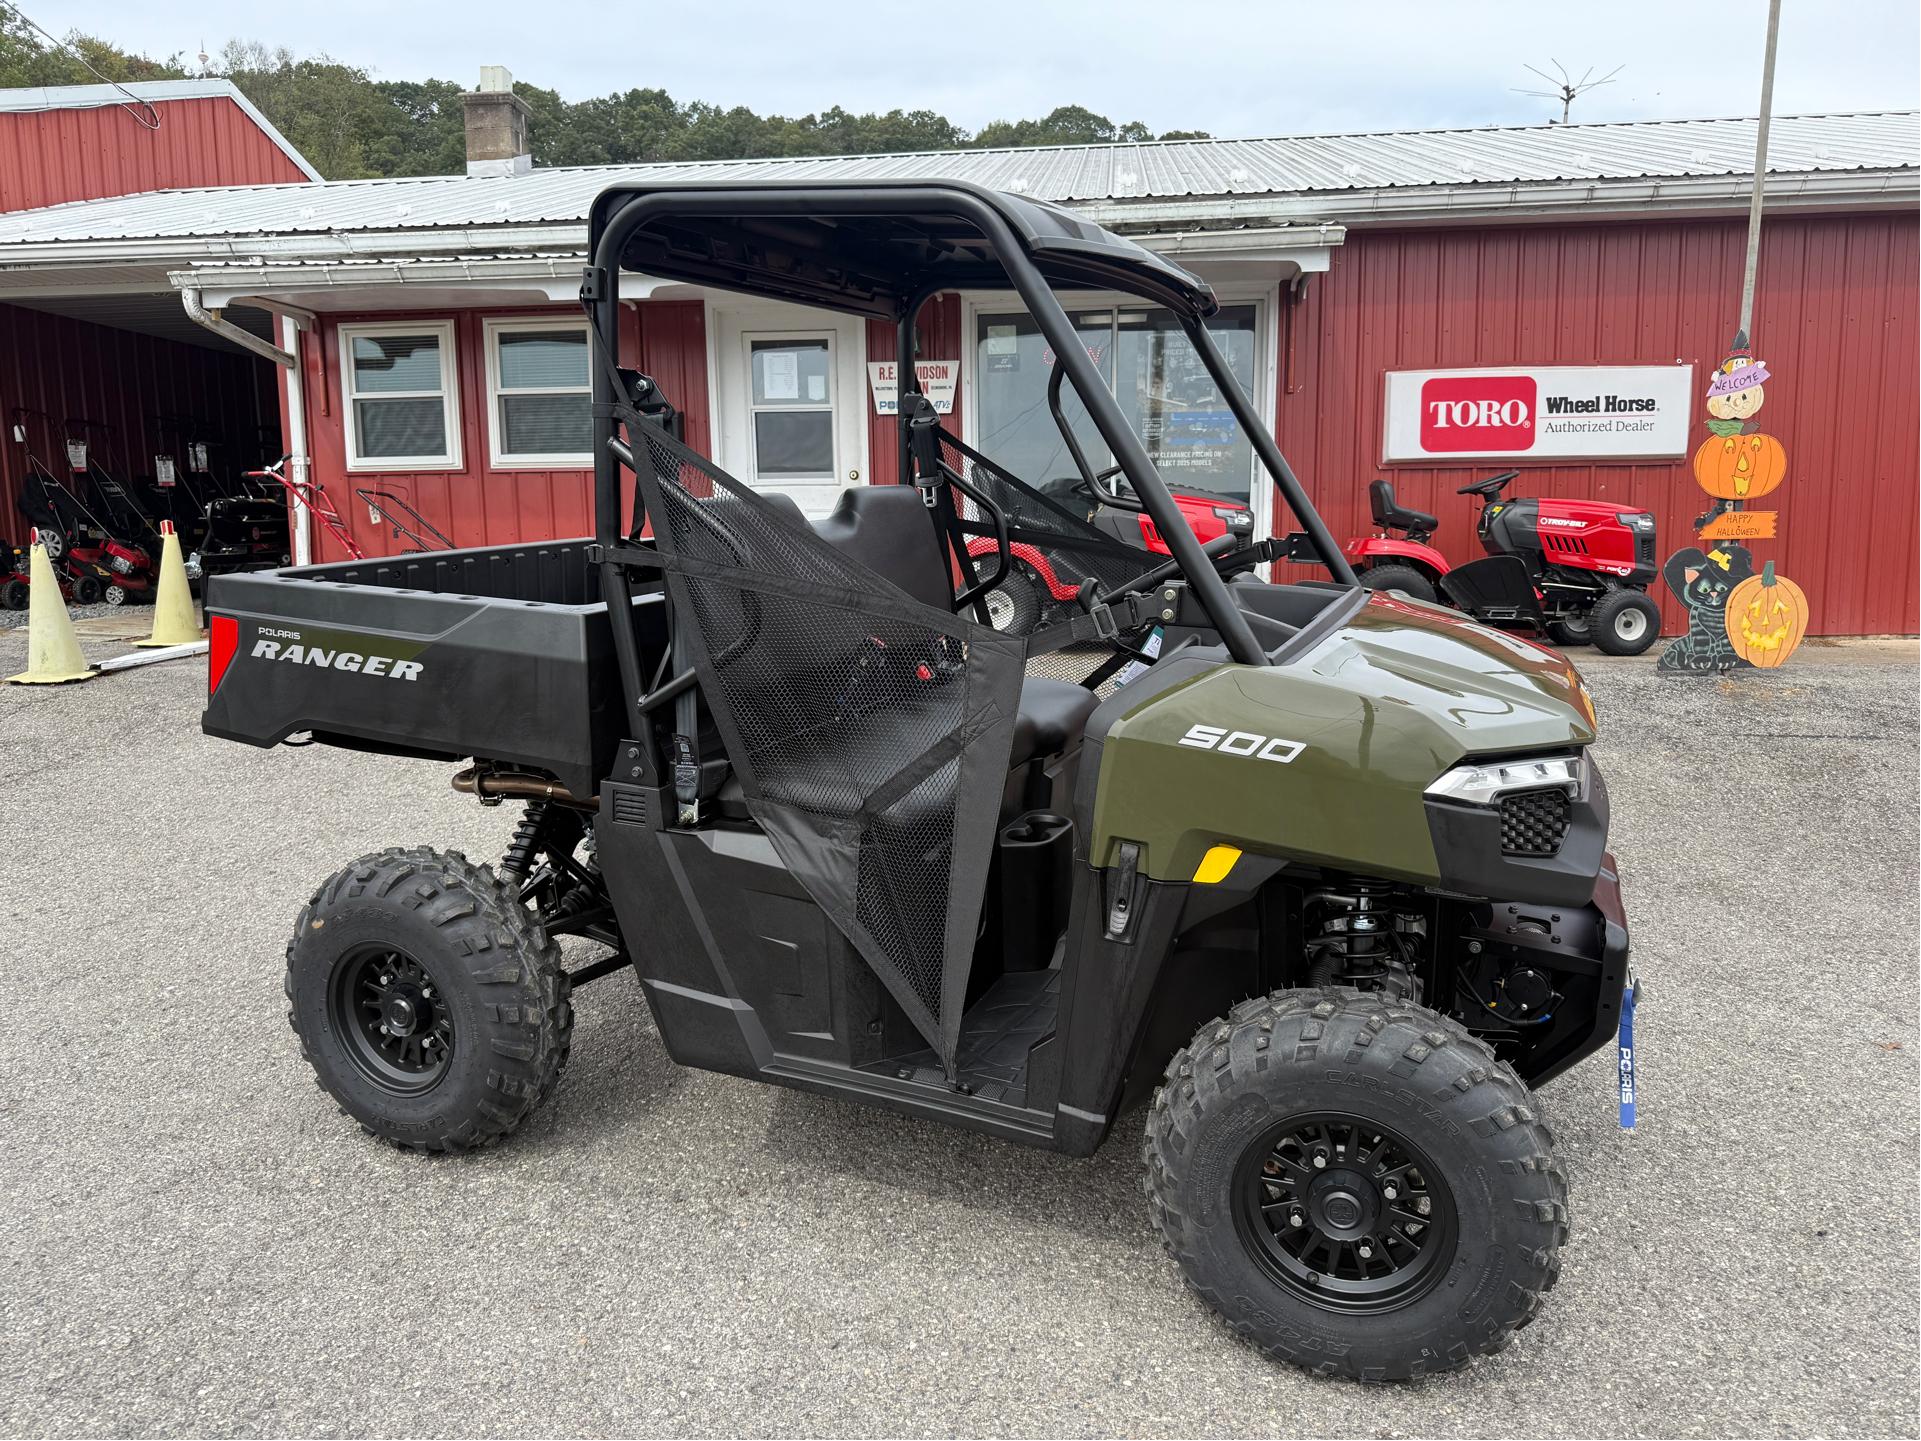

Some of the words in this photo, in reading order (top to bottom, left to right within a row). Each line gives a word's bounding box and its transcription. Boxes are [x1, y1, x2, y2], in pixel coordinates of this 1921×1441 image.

[879, 366, 897, 381] R.E.
[1714, 371, 1760, 392] WELCOME
[1430, 399, 1529, 428] TORO
[1545, 396, 1601, 414] Wheel
[1604, 395, 1656, 413] Horse
[1544, 420, 1614, 434] Authorized
[1615, 419, 1655, 432] Dealer
[1547, 518, 1588, 528] TROY-BILT
[1726, 514, 1753, 524] HAPPY
[1716, 528, 1760, 537] HALLOWEEN
[258, 626, 301, 640] POLARIS
[250, 639, 424, 682] RANGER
[1177, 723, 1307, 764] 500
[1620, 1047, 1633, 1105] POLARIS
[1325, 1069, 1461, 1138] CARLSTAR
